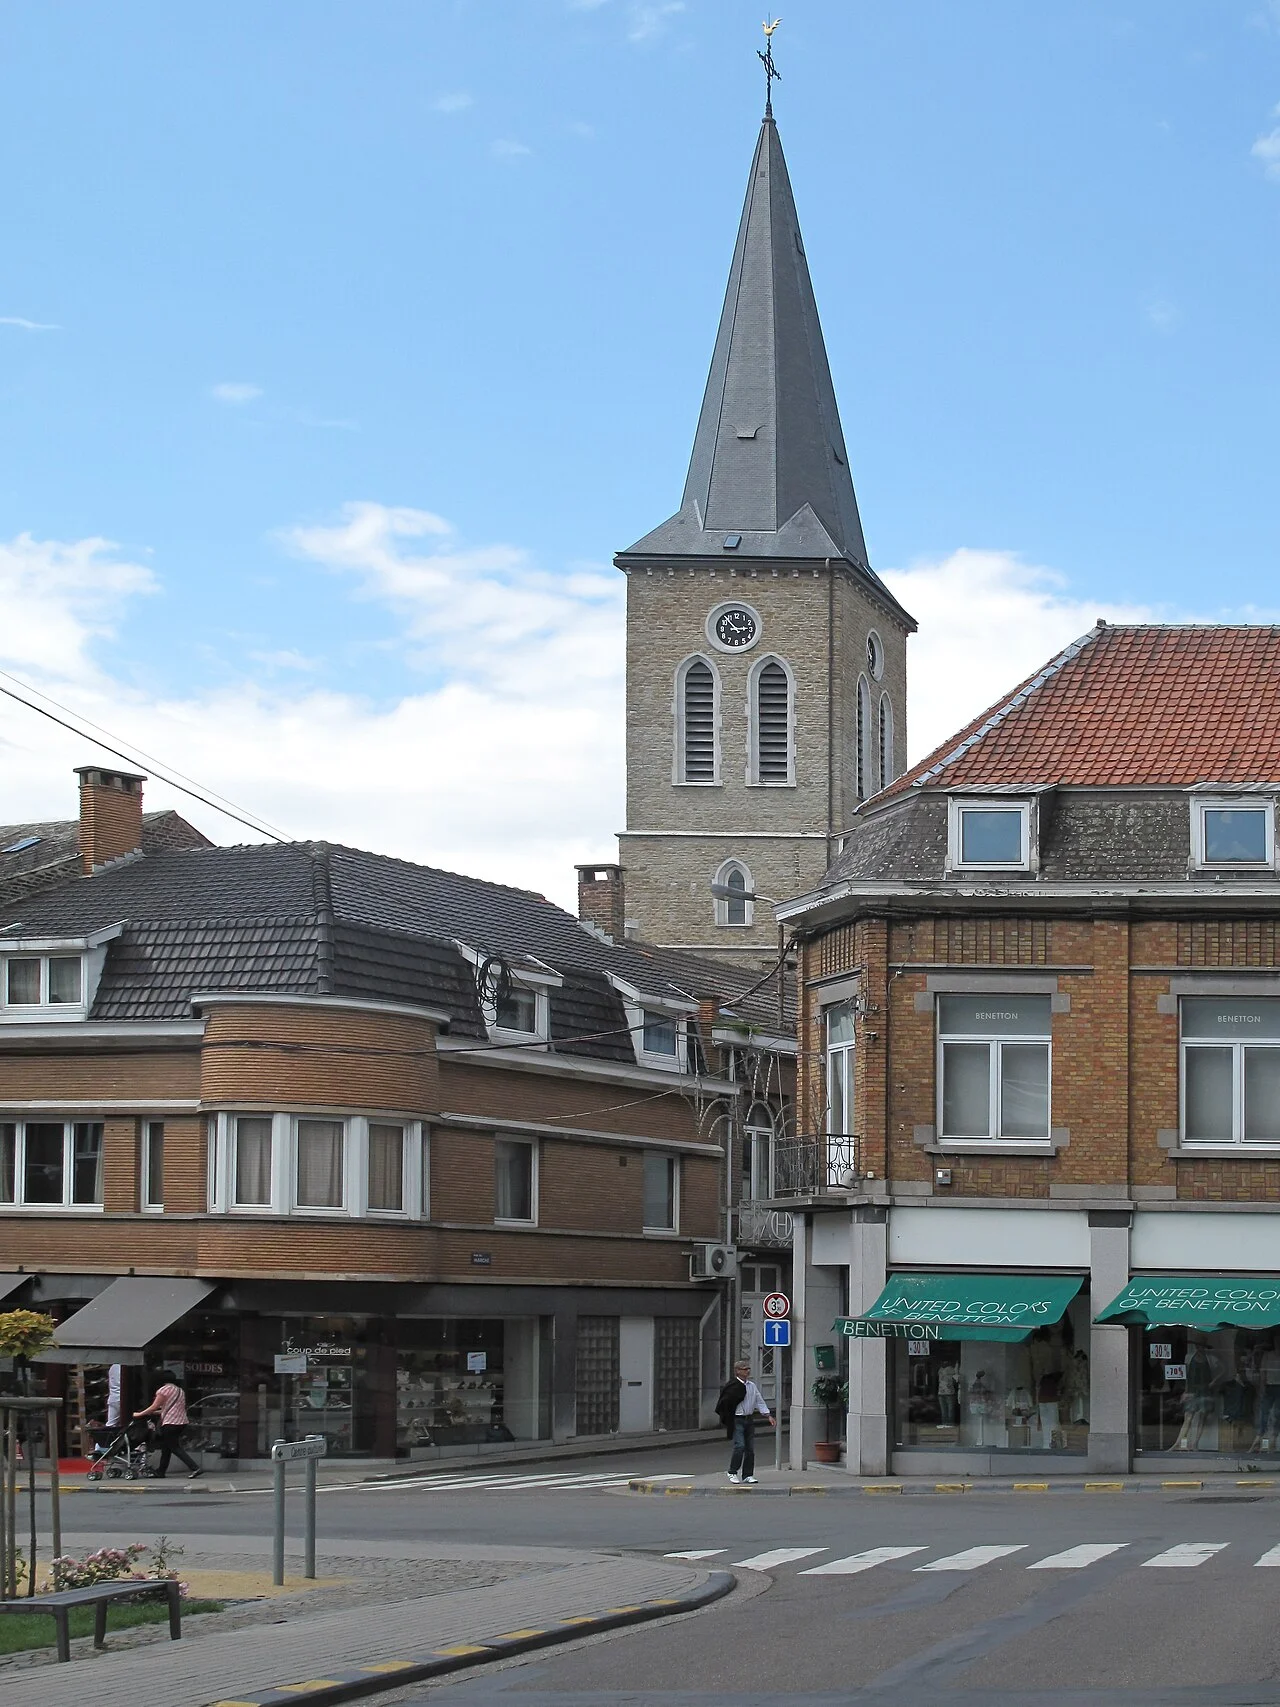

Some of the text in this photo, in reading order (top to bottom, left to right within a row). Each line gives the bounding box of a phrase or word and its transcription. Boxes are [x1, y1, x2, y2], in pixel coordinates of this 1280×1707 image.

[975, 1012, 1018, 1020] BENETTON
[1217, 1015, 1261, 1023] BENETTON
[1128, 1288, 1209, 1298] UNITED
[881, 1296, 1052, 1315] UNITED COLORS
[1119, 1299, 1153, 1309] OF
[286, 1347, 312, 1355] coup
[329, 1347, 351, 1355] pied
[184, 1362, 223, 1374] SOLDES
